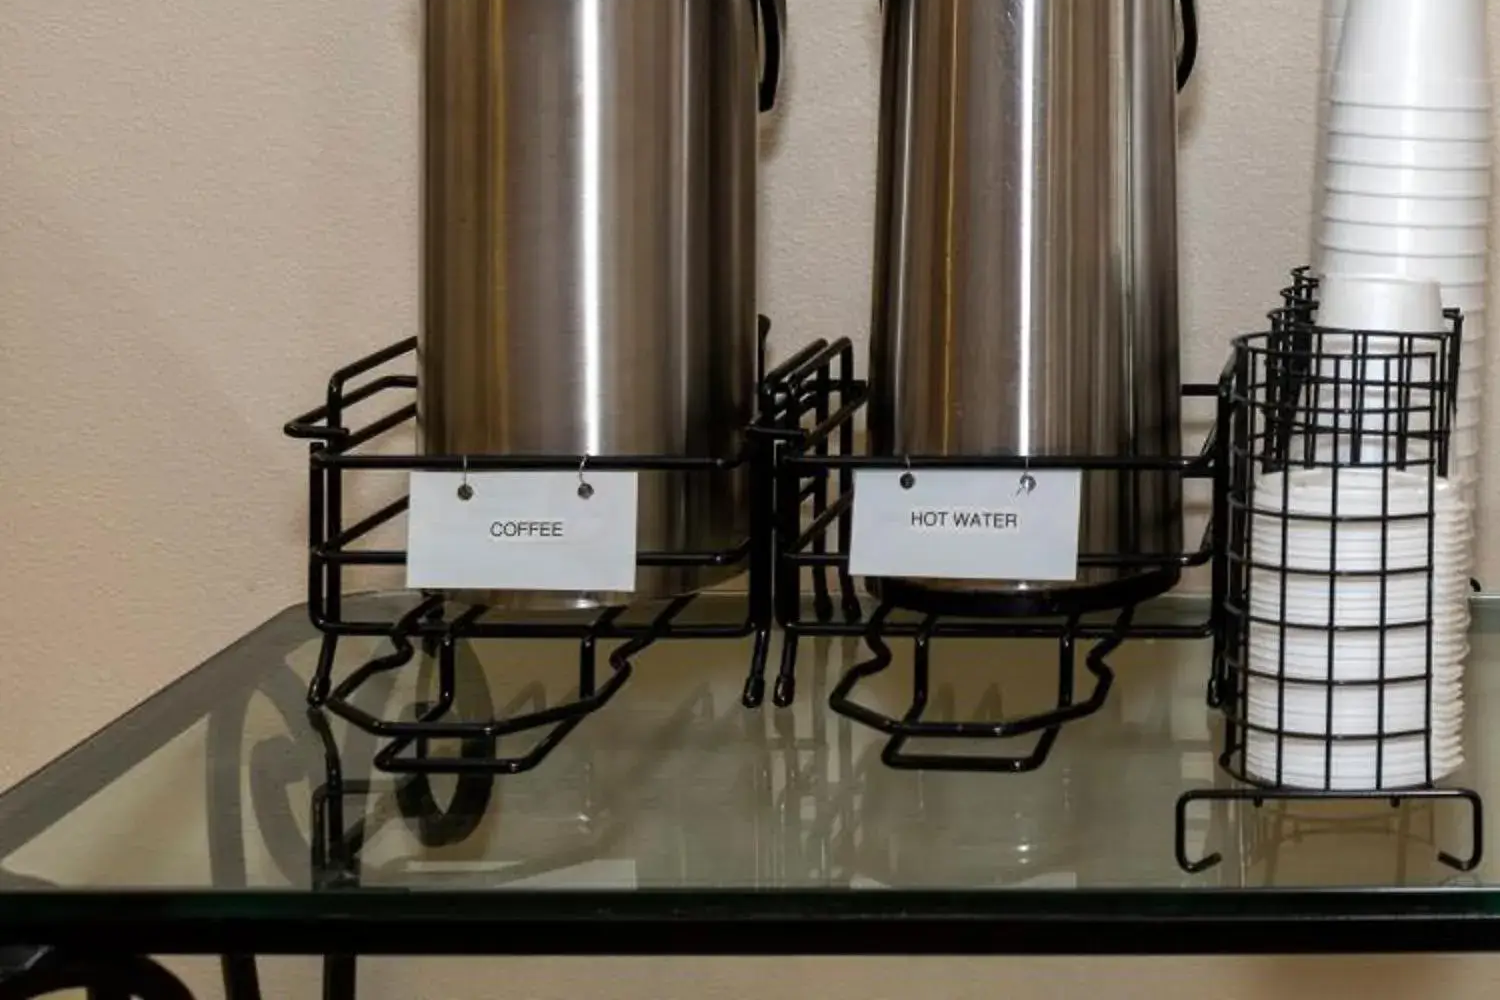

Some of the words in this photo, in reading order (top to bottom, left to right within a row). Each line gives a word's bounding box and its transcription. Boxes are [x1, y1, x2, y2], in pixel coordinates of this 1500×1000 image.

[910, 511, 948, 527] HOT
[953, 512, 1018, 529] WATER
[490, 521, 564, 537] COFFEE
